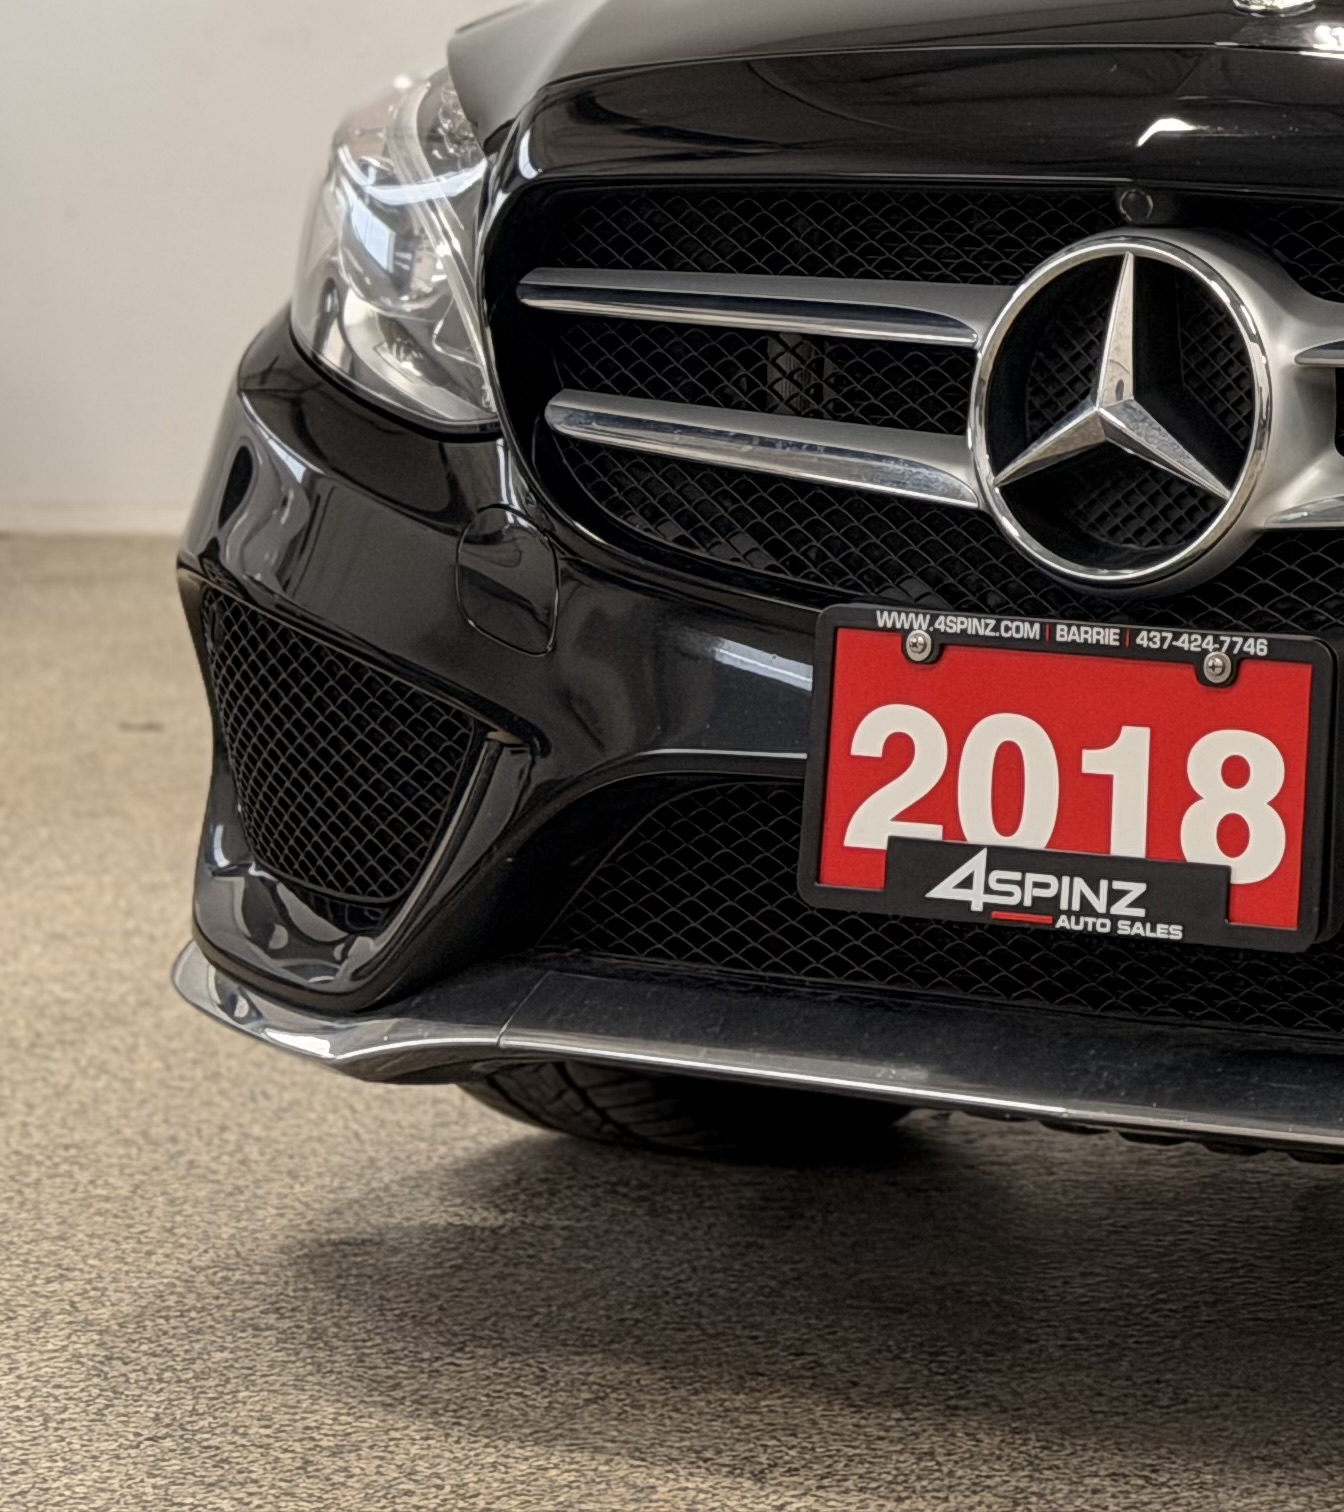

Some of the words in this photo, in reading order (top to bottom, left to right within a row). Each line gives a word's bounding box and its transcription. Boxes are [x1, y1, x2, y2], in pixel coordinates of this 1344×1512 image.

[876, 609, 1041, 640] WWW.4SPINZ.COM
[1055, 624, 1120, 646] BARRIE
[1135, 630, 1269, 657] 437-424-7746
[843, 703, 1287, 885] 2018
[924, 847, 1148, 918] 4SPINZ
[1055, 914, 1112, 934] AUTO
[1117, 919, 1184, 940] SALES
